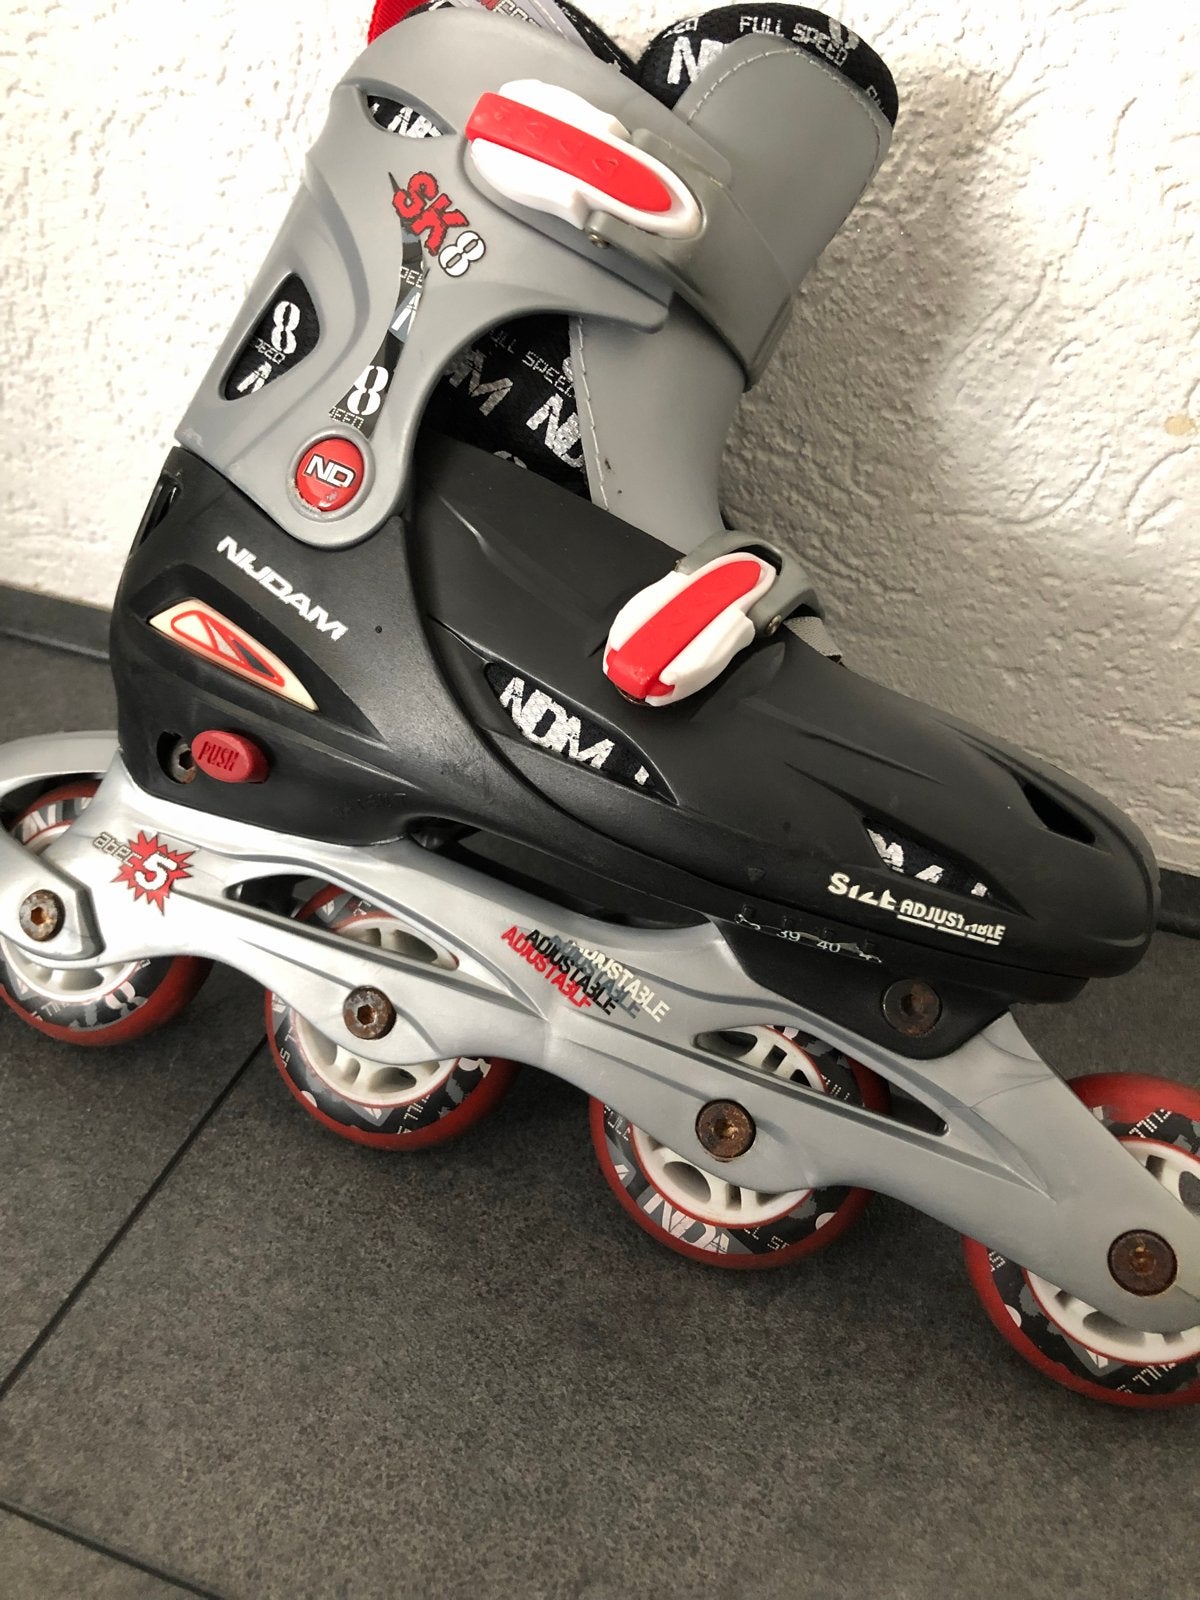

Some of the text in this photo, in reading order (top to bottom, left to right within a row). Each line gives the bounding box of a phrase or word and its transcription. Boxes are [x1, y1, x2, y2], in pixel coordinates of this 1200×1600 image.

[739, 15, 785, 38] FULL
[791, 22, 849, 67] SPEED
[392, 171, 486, 278] SK8
[271, 300, 301, 354] 8
[304, 453, 356, 488] ND
[198, 741, 240, 772] PUSH
[133, 851, 179, 891] 5
[525, 929, 617, 1016] ADJUSTABLE
